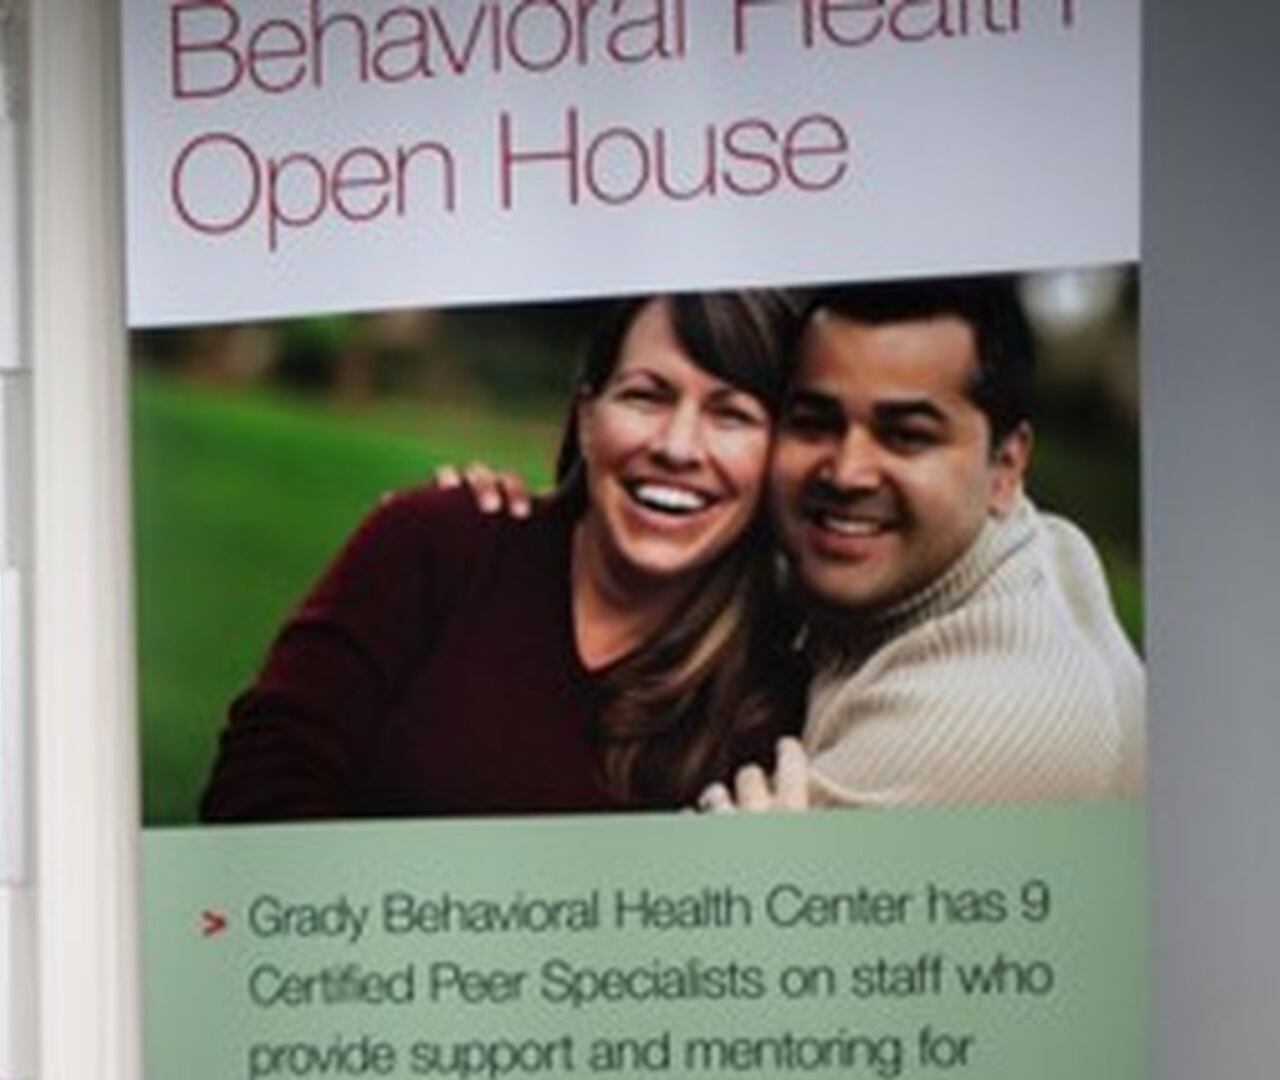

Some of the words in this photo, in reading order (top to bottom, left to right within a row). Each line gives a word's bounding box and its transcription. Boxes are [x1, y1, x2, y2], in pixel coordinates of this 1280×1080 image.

[170, 0, 685, 100] Behavioral
[171, 132, 455, 253] Open
[500, 107, 849, 210] House
[248, 894, 370, 943] Grady
[383, 890, 600, 934] Behavioral
[615, 886, 752, 930] Health
[765, 884, 913, 927] Center
[927, 883, 1008, 924] has
[1021, 879, 1051, 922] 9
[248, 963, 415, 1008] Certified
[429, 962, 528, 1004] Peer
[541, 958, 767, 1009] Specialists
[779, 965, 836, 999] on
[851, 955, 942, 998] staff
[956, 954, 1054, 995] who
[410, 1035, 574, 1080] support
[588, 1032, 671, 1072] and
[685, 1029, 904, 1080] mentoring
[918, 1026, 974, 1069] for
